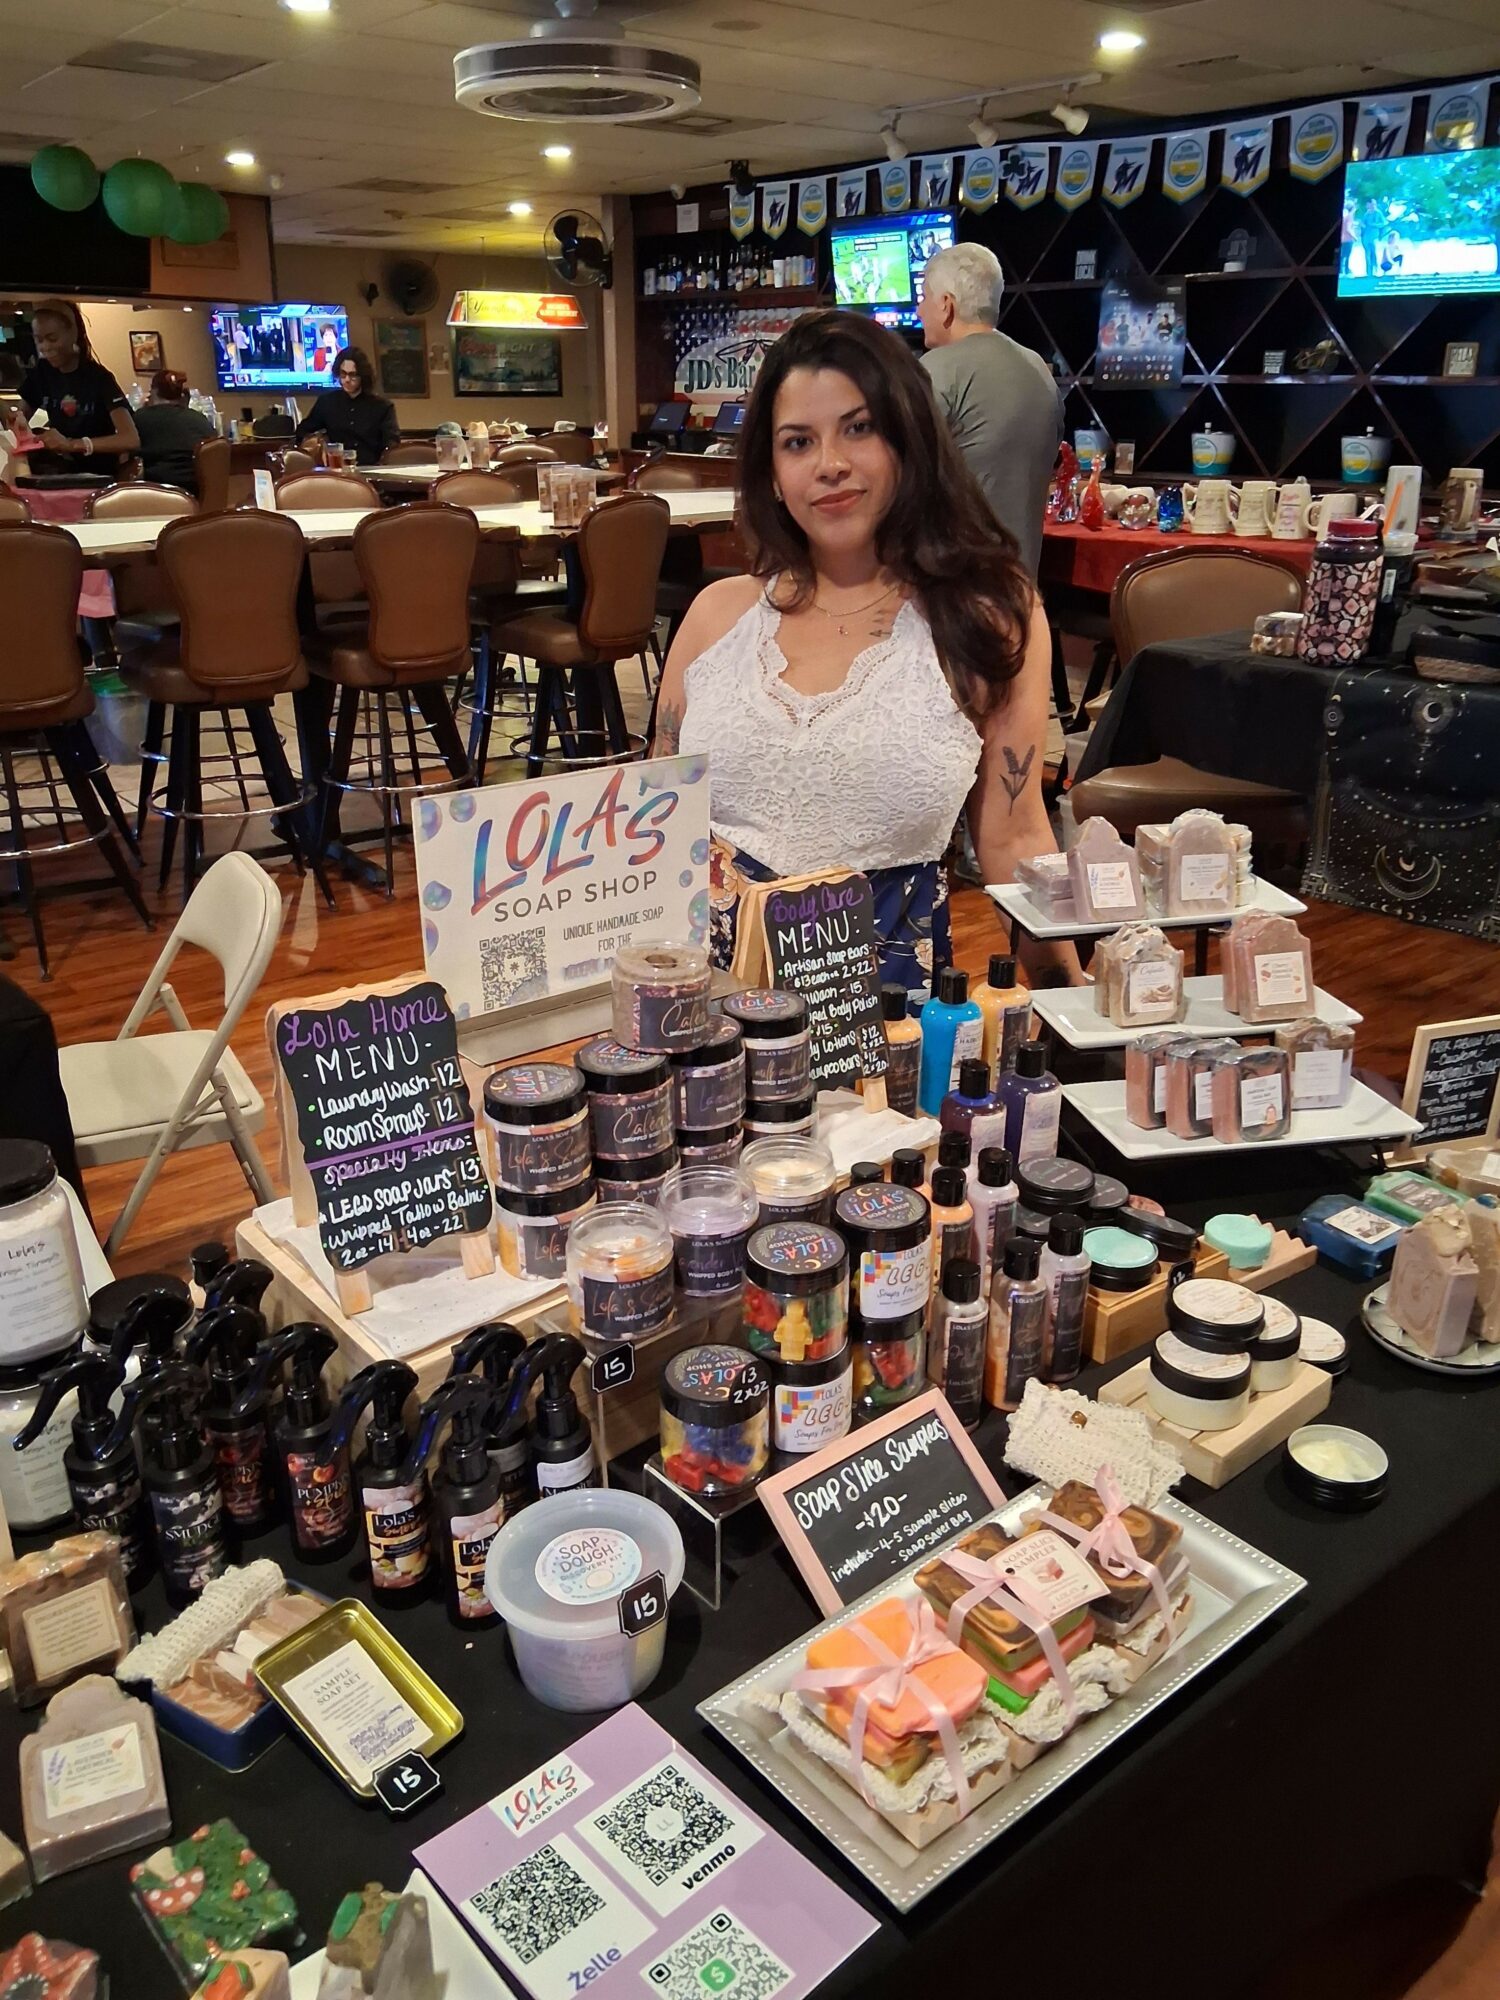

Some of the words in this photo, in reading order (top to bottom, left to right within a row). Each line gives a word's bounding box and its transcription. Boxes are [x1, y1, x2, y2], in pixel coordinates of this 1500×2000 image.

[684, 357, 722, 394] JD's
[727, 355, 756, 389] Bar
[471, 767, 679, 916] LOLA'S
[494, 887, 572, 923] SOAP
[584, 870, 657, 903] SHOP
[563, 924, 595, 941] UNIQUE
[596, 912, 641, 934] HANDMADE
[642, 905, 665, 922] SOAP
[598, 938, 615, 953] FOR
[783, 956, 825, 979] Artisan
[849, 980, 863, 994] 15
[283, 1013, 360, 1055] Lola
[370, 996, 448, 1034] Home
[319, 1088, 386, 1119] Laundry
[437, 1062, 462, 1090] 12
[322, 1120, 376, 1151] Room
[436, 1096, 459, 1123] 12
[853, 1191, 904, 1217] LOLA'S
[772, 1235, 830, 1262] LOLA'S
[603, 1357, 627, 1381] 15
[741, 1366, 758, 1384] 13
[793, 1477, 843, 1530] Soap
[840, 1457, 889, 1502] Slice
[375, 1510, 416, 1528] Lola's
[559, 1536, 600, 1560] SOAP
[560, 1544, 615, 1573] DOUGH
[1002, 1547, 1028, 1565] SOAP
[1013, 1544, 1058, 1570] SAMPLER
[633, 1592, 658, 1621] 15
[313, 1666, 354, 1696] SAMPLE
[316, 1687, 342, 1706] SOAP
[345, 1673, 363, 1688] SET
[392, 1764, 422, 1794] 15
[503, 1764, 578, 1832] LOLA'S
[528, 1804, 556, 1825] SOAP
[554, 1787, 579, 1808] SHOP
[681, 1843, 737, 1892] venmo
[567, 1944, 623, 1993] Zelle
